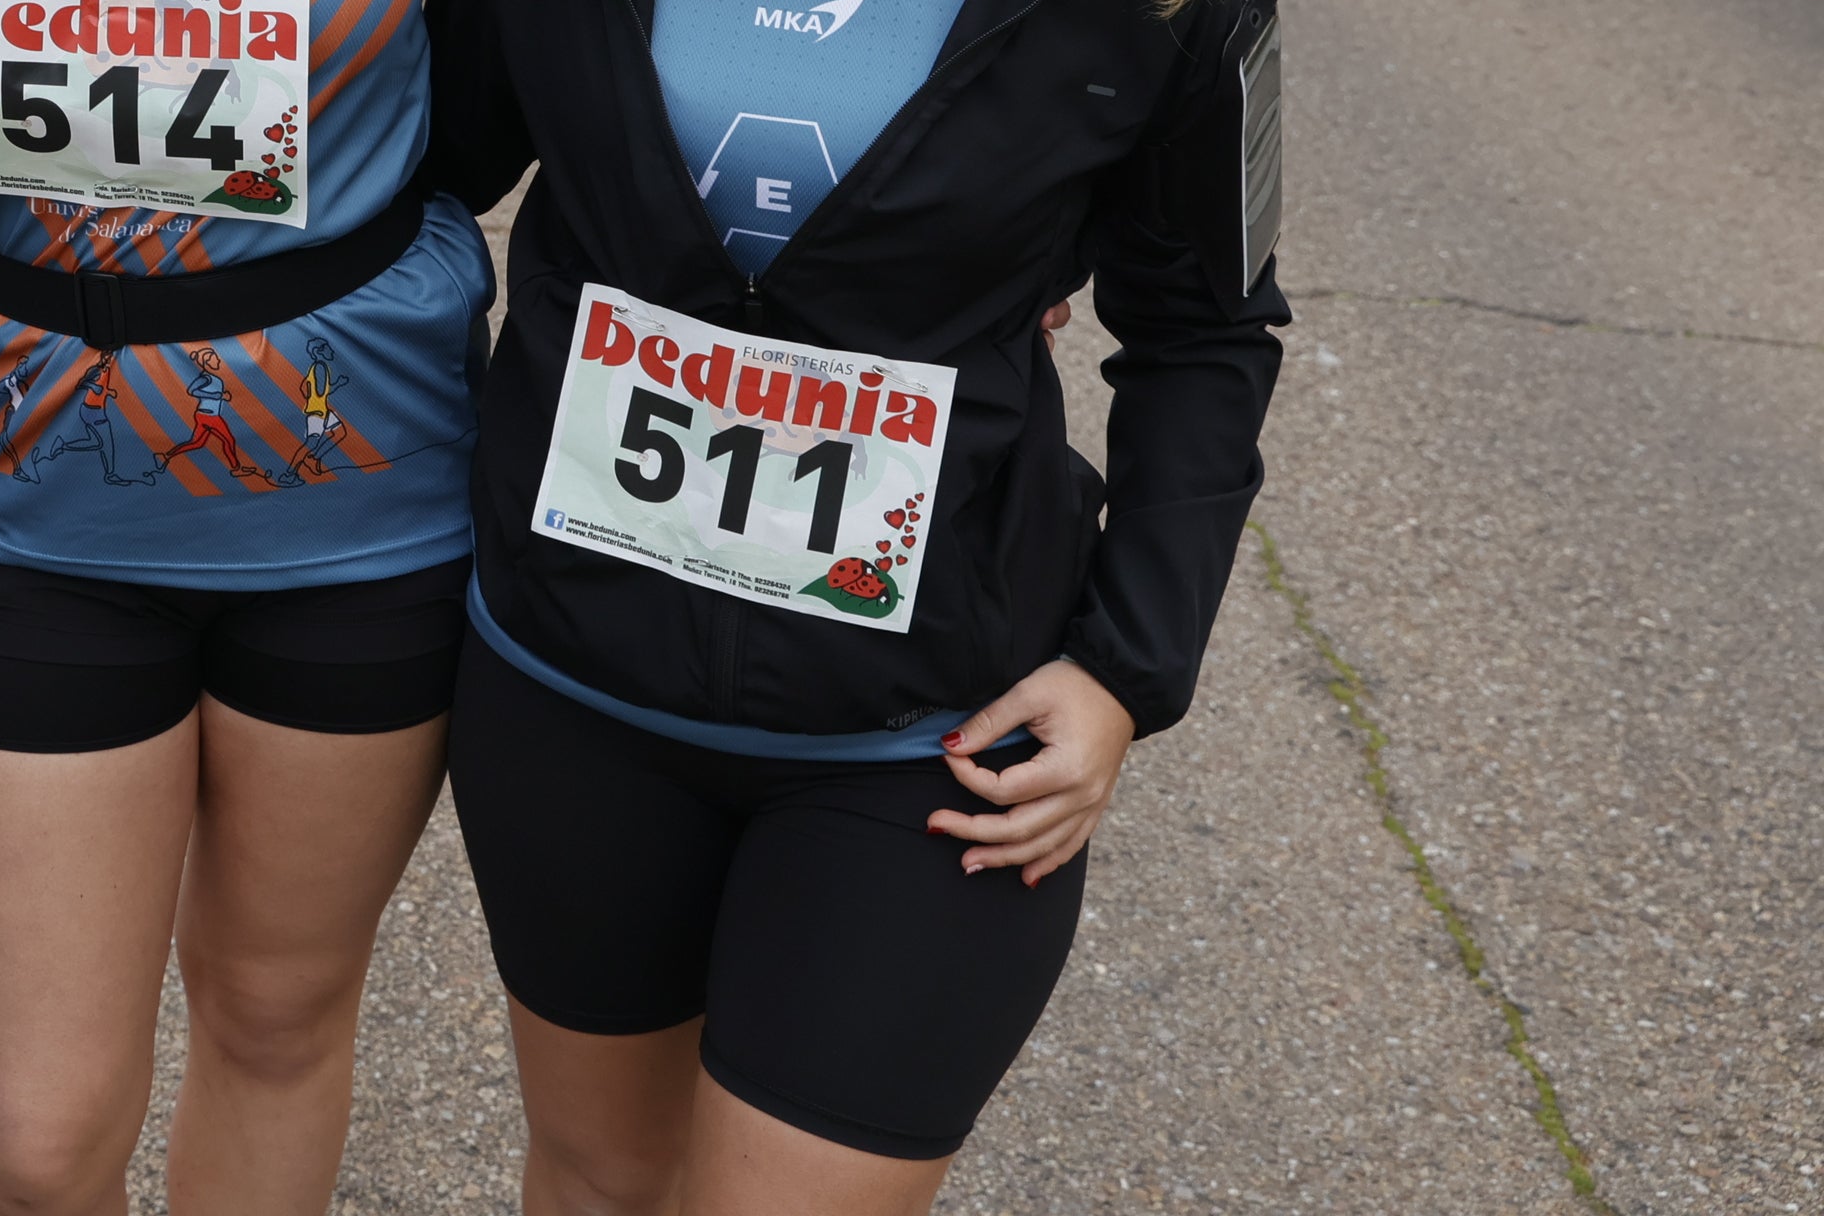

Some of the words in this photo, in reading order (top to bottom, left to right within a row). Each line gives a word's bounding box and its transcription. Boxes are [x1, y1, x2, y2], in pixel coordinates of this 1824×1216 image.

[754, 6, 823, 36] MKA
[1, 60, 244, 172] 514
[580, 300, 938, 447] bedunia
[742, 345, 855, 376] FLORISTERÍAS
[614, 385, 854, 555] 511
[565, 524, 673, 565] www.floristeriasbedunia.com
[567, 515, 637, 543] www.bedunia.com
